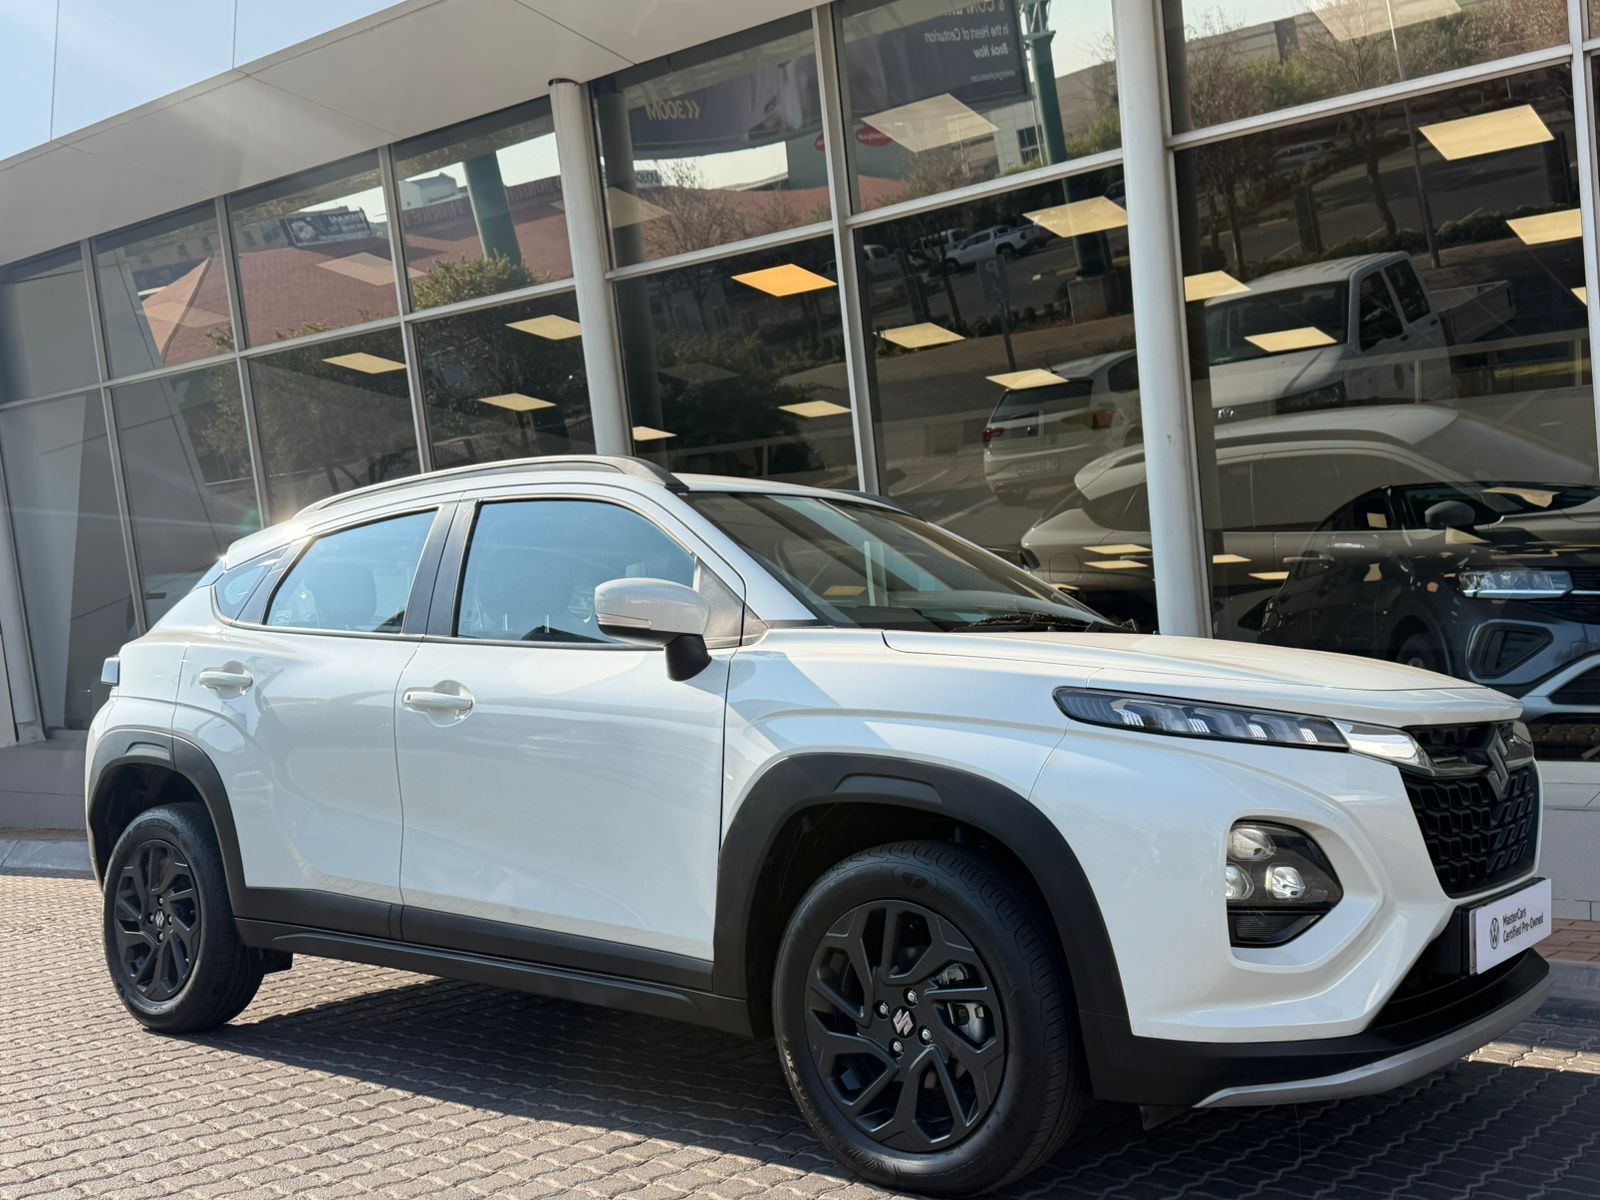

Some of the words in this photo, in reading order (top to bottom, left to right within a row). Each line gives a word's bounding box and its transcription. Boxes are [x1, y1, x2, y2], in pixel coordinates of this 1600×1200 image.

[1503, 907, 1526, 926] MasterCars
[1503, 925, 1521, 942] Certified
[1522, 913, 1543, 931] Pre-Owned
